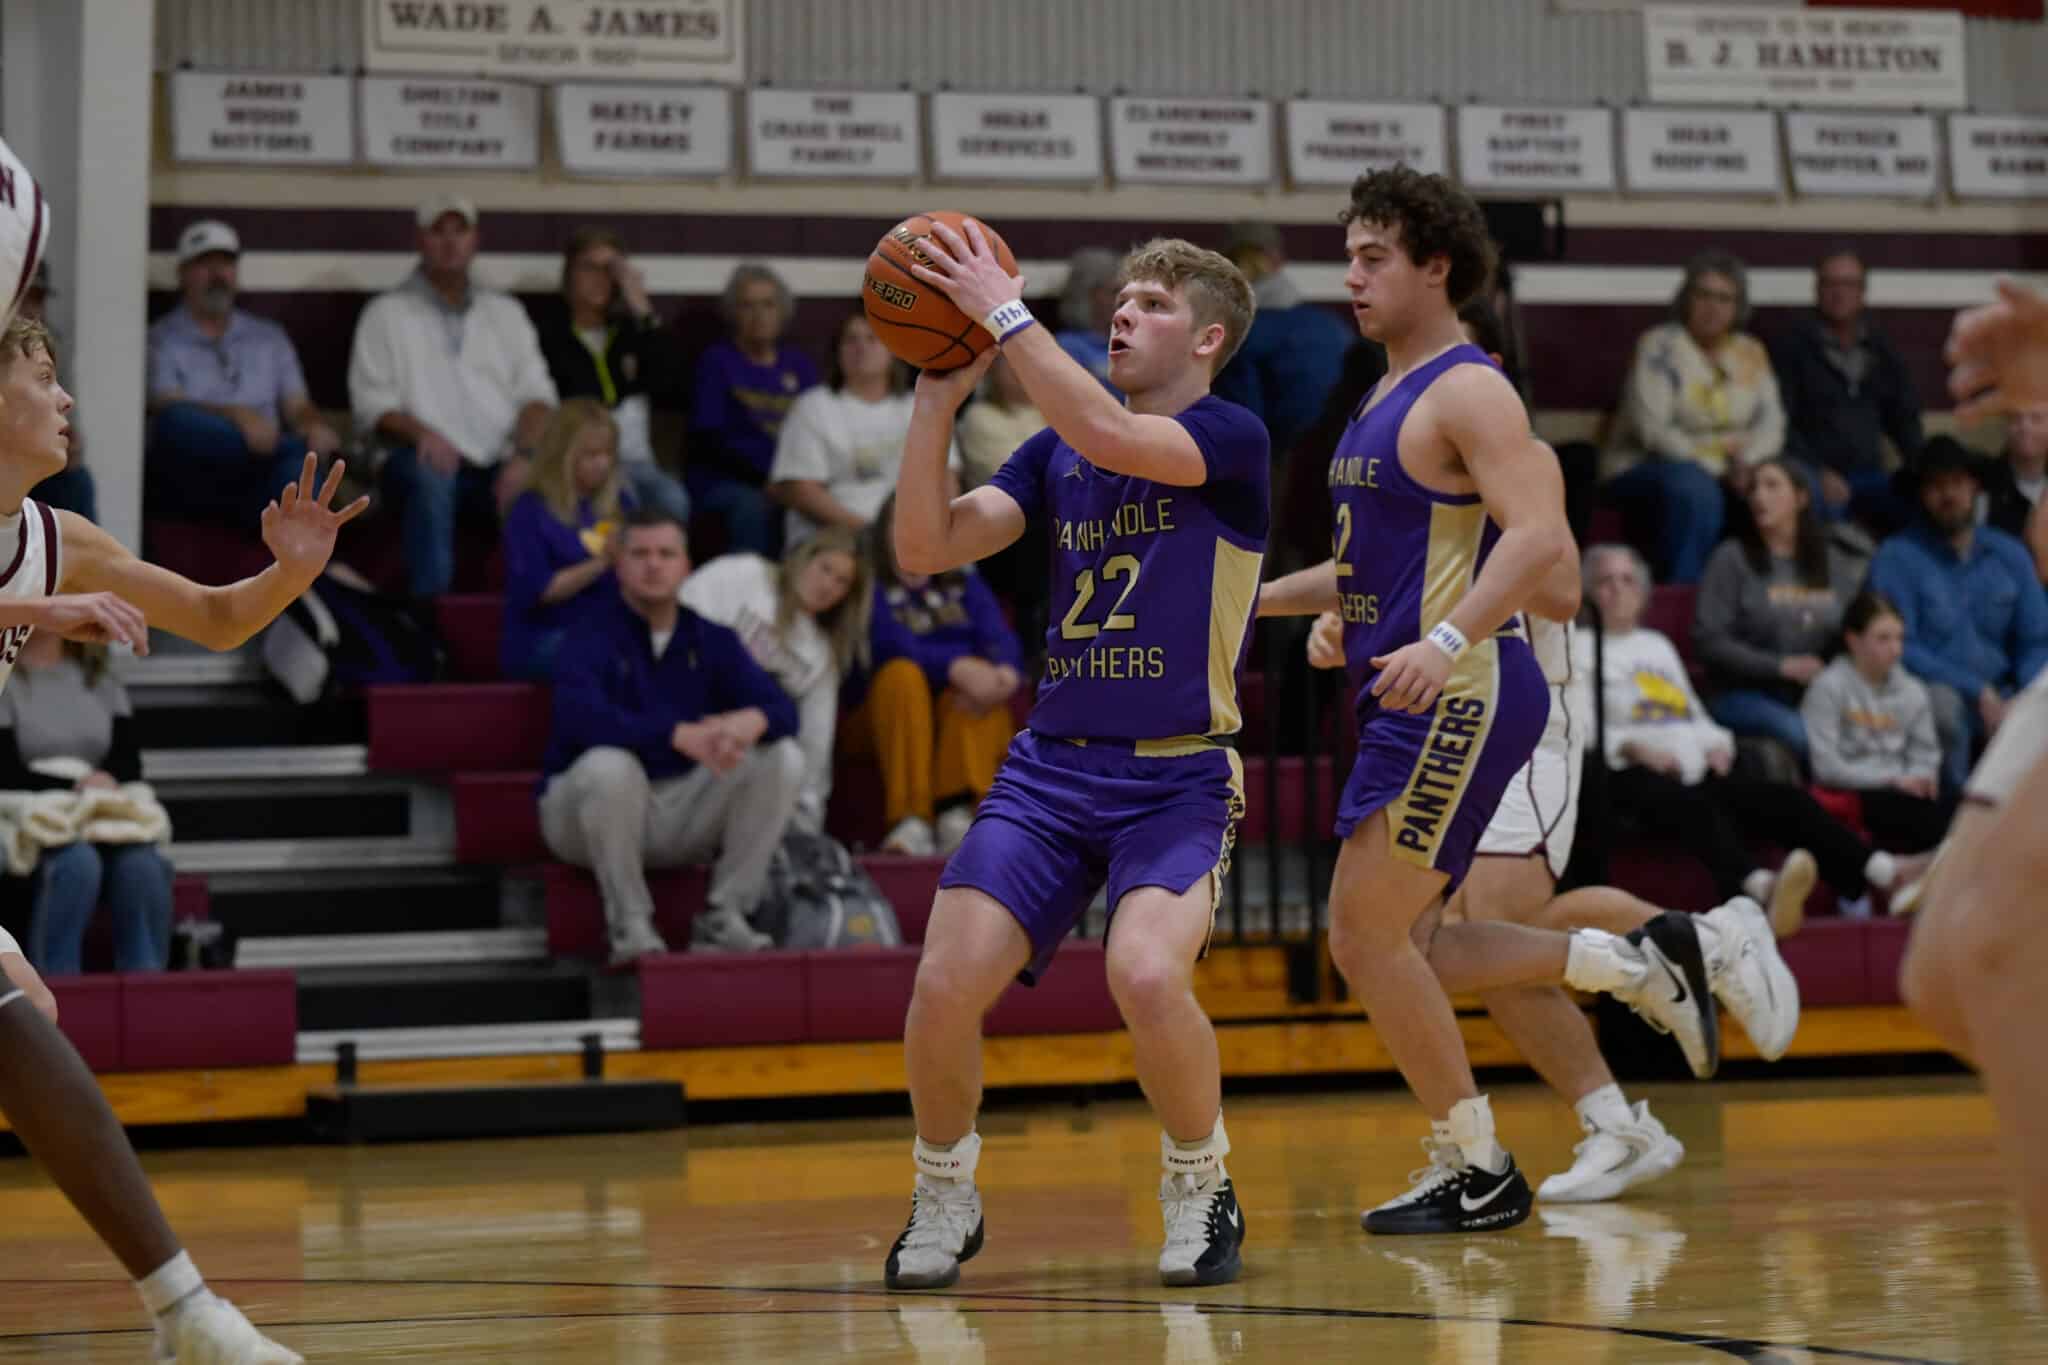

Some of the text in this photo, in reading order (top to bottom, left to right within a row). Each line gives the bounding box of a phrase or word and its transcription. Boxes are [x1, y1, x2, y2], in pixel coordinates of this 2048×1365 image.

[389, 2, 508, 32] WADE
[582, 8, 721, 39] JAMES
[1756, 44, 1942, 72] HAMILTON
[224, 81, 302, 99] JAMES
[227, 108, 300, 124] WOOD
[590, 102, 693, 124] HATLEY
[210, 132, 312, 151] MOTORS
[390, 137, 503, 155] COMPANY
[594, 131, 692, 152] FARMS
[1148, 130, 1229, 147] FAMILY
[790, 147, 875, 163] FAMILY
[1135, 154, 1245, 172] MEDICINE
[1061, 554, 1140, 640] 22
[1396, 697, 1485, 853] PANTHERS
